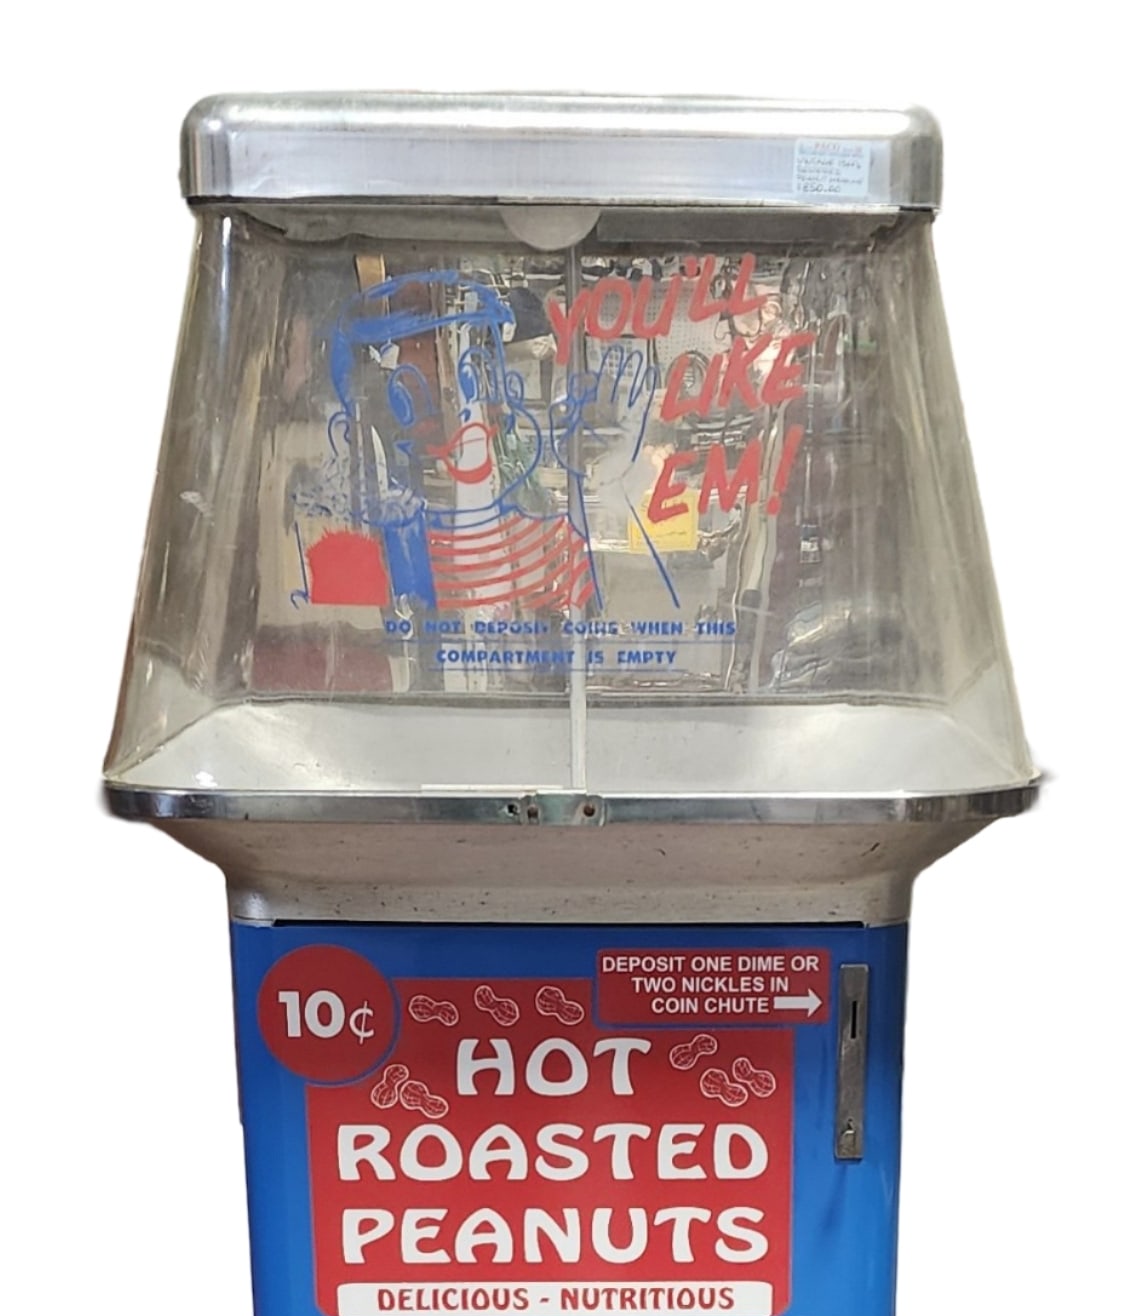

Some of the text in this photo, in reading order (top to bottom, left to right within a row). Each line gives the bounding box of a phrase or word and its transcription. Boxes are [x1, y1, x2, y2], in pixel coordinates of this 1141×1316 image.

[548, 253, 769, 365] YOU'LL
[660, 332, 815, 421] LIKE
[648, 425, 803, 522] EM!
[385, 620, 411, 635] DO
[425, 620, 460, 634] NOT
[632, 621, 683, 635] WHEN
[696, 621, 736, 635] THIS
[436, 649, 677, 665] COMPARTMENT IS EMPTY
[603, 957, 818, 971] DEPOSIT ONE DIME OR
[633, 977, 787, 992] TWO NICKLES IN
[653, 998, 767, 1012] COIN CHUTE
[458, 1039, 650, 1095] HOT
[338, 1124, 768, 1180] ROASTED
[343, 1207, 768, 1263] PEANUTS
[378, 1288, 528, 1310] DELICIOUS
[561, 1288, 733, 1310] NUTRITIOUS
